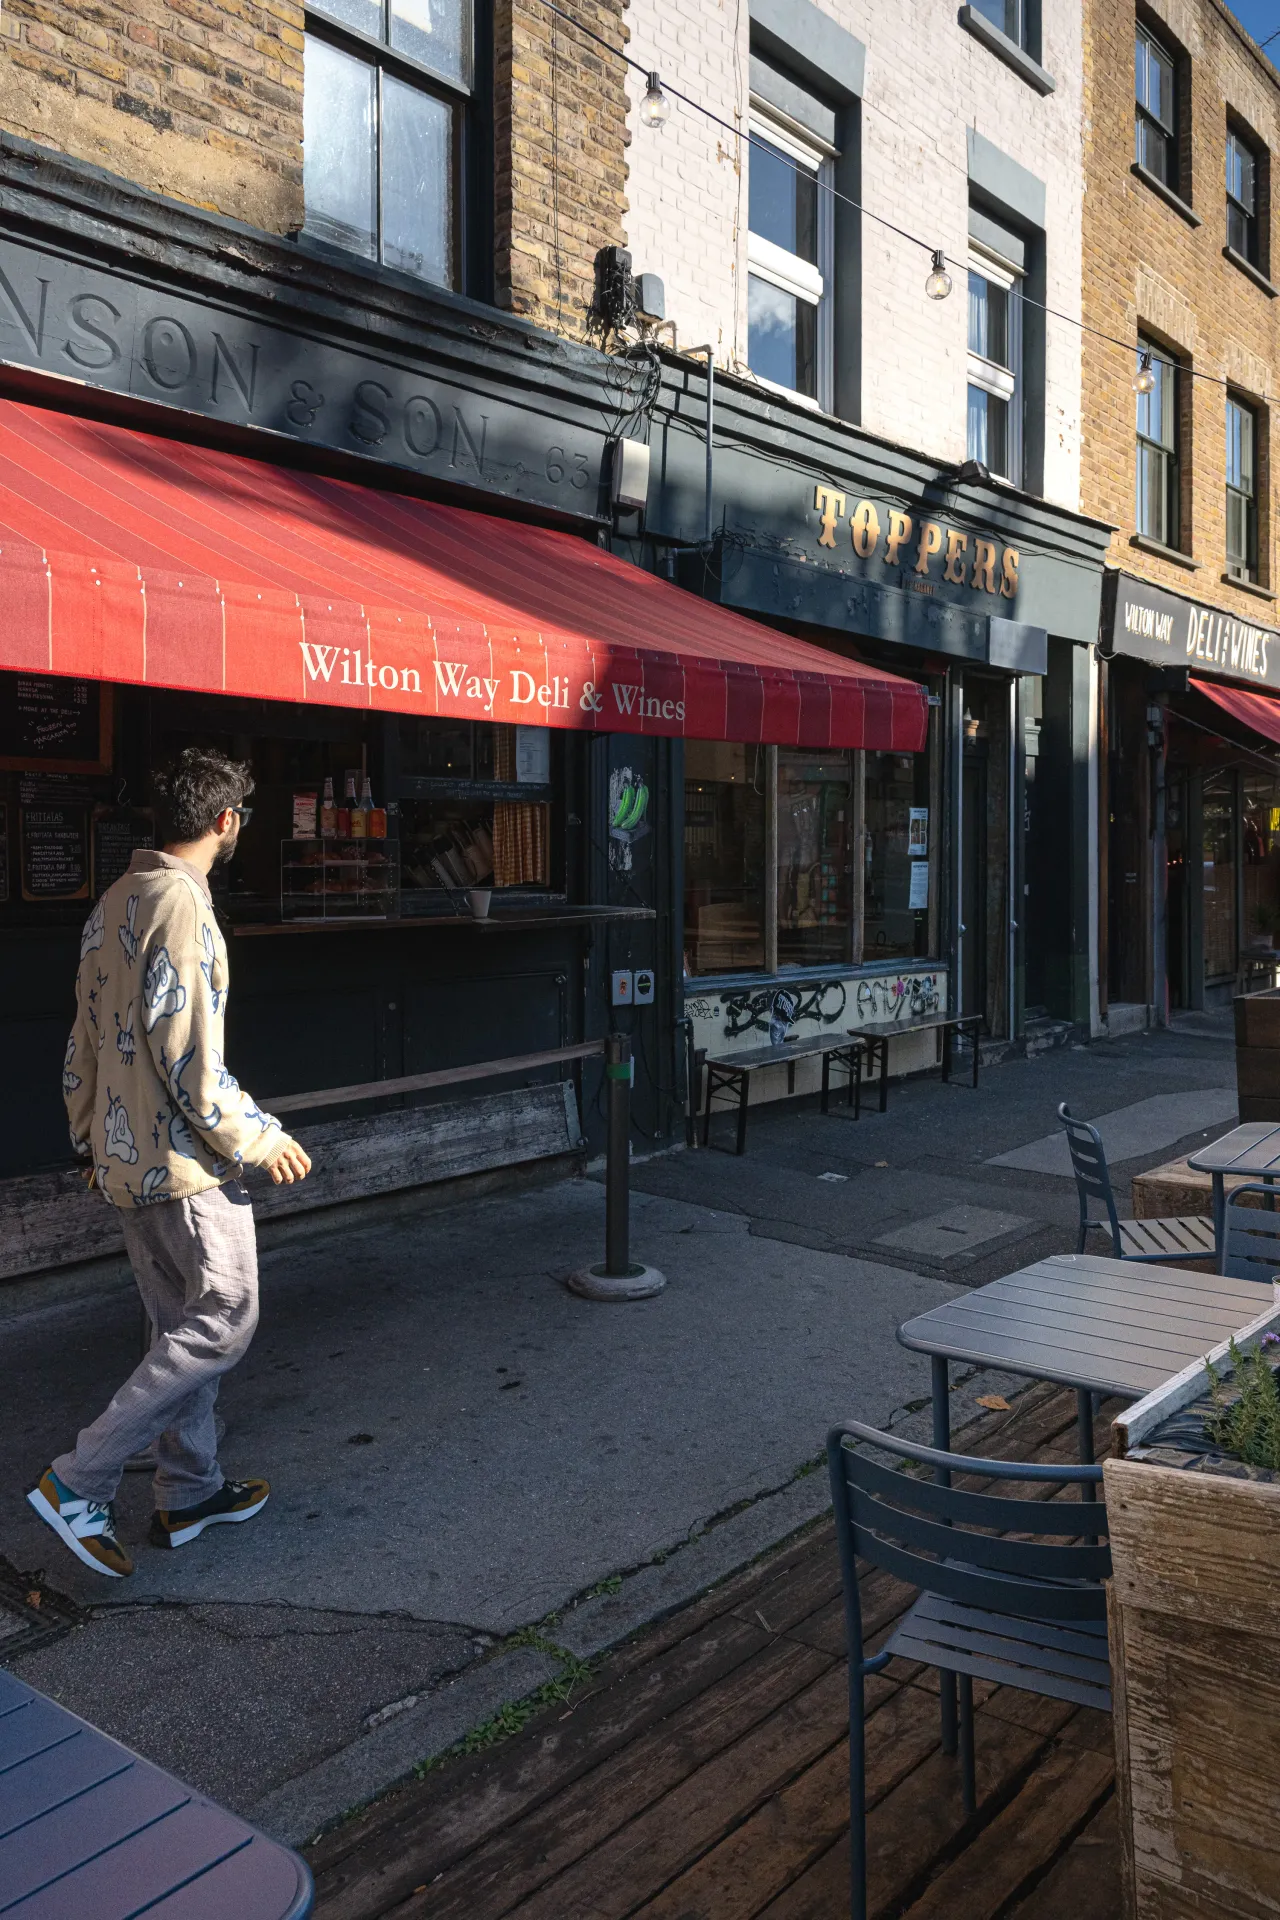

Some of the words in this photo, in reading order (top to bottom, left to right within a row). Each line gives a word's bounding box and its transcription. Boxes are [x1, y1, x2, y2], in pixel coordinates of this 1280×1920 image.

[286, 379, 326, 429] &
[348, 379, 490, 478] SON
[545, 446, 590, 490] 63
[813, 485, 1020, 600] TOPPERS
[1125, 601, 1155, 638] WILTON
[1155, 611, 1174, 645] WAY
[1186, 606, 1222, 663] DELI
[1230, 622, 1270, 679] WINES
[299, 641, 422, 693] Wilton
[433, 660, 501, 711] Way
[509, 670, 571, 709] Deli
[580, 681, 603, 712] &
[612, 682, 686, 721] Wines
[25, 811, 64, 822] FRITTATAS
